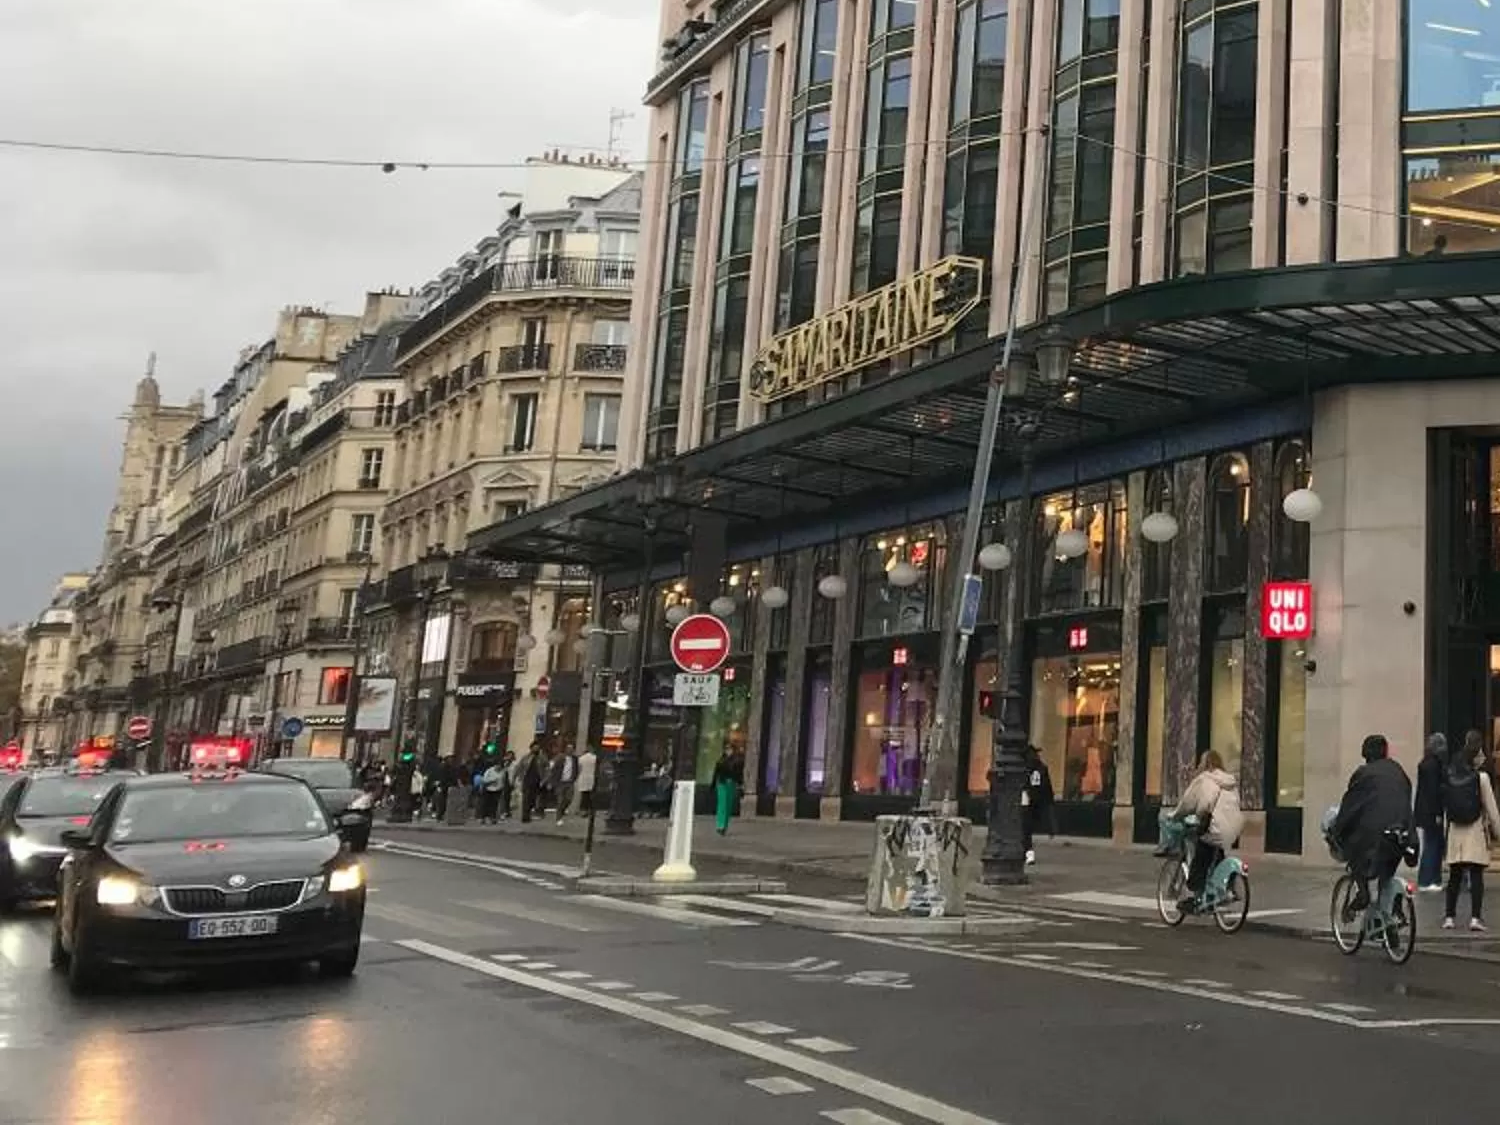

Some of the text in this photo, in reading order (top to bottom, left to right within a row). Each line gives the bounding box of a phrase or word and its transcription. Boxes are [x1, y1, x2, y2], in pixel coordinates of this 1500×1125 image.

[763, 262, 950, 395] SAMARITAINE
[1270, 589, 1304, 609] UNI
[1270, 611, 1306, 634] QLO
[683, 676, 713, 684] SAUF
